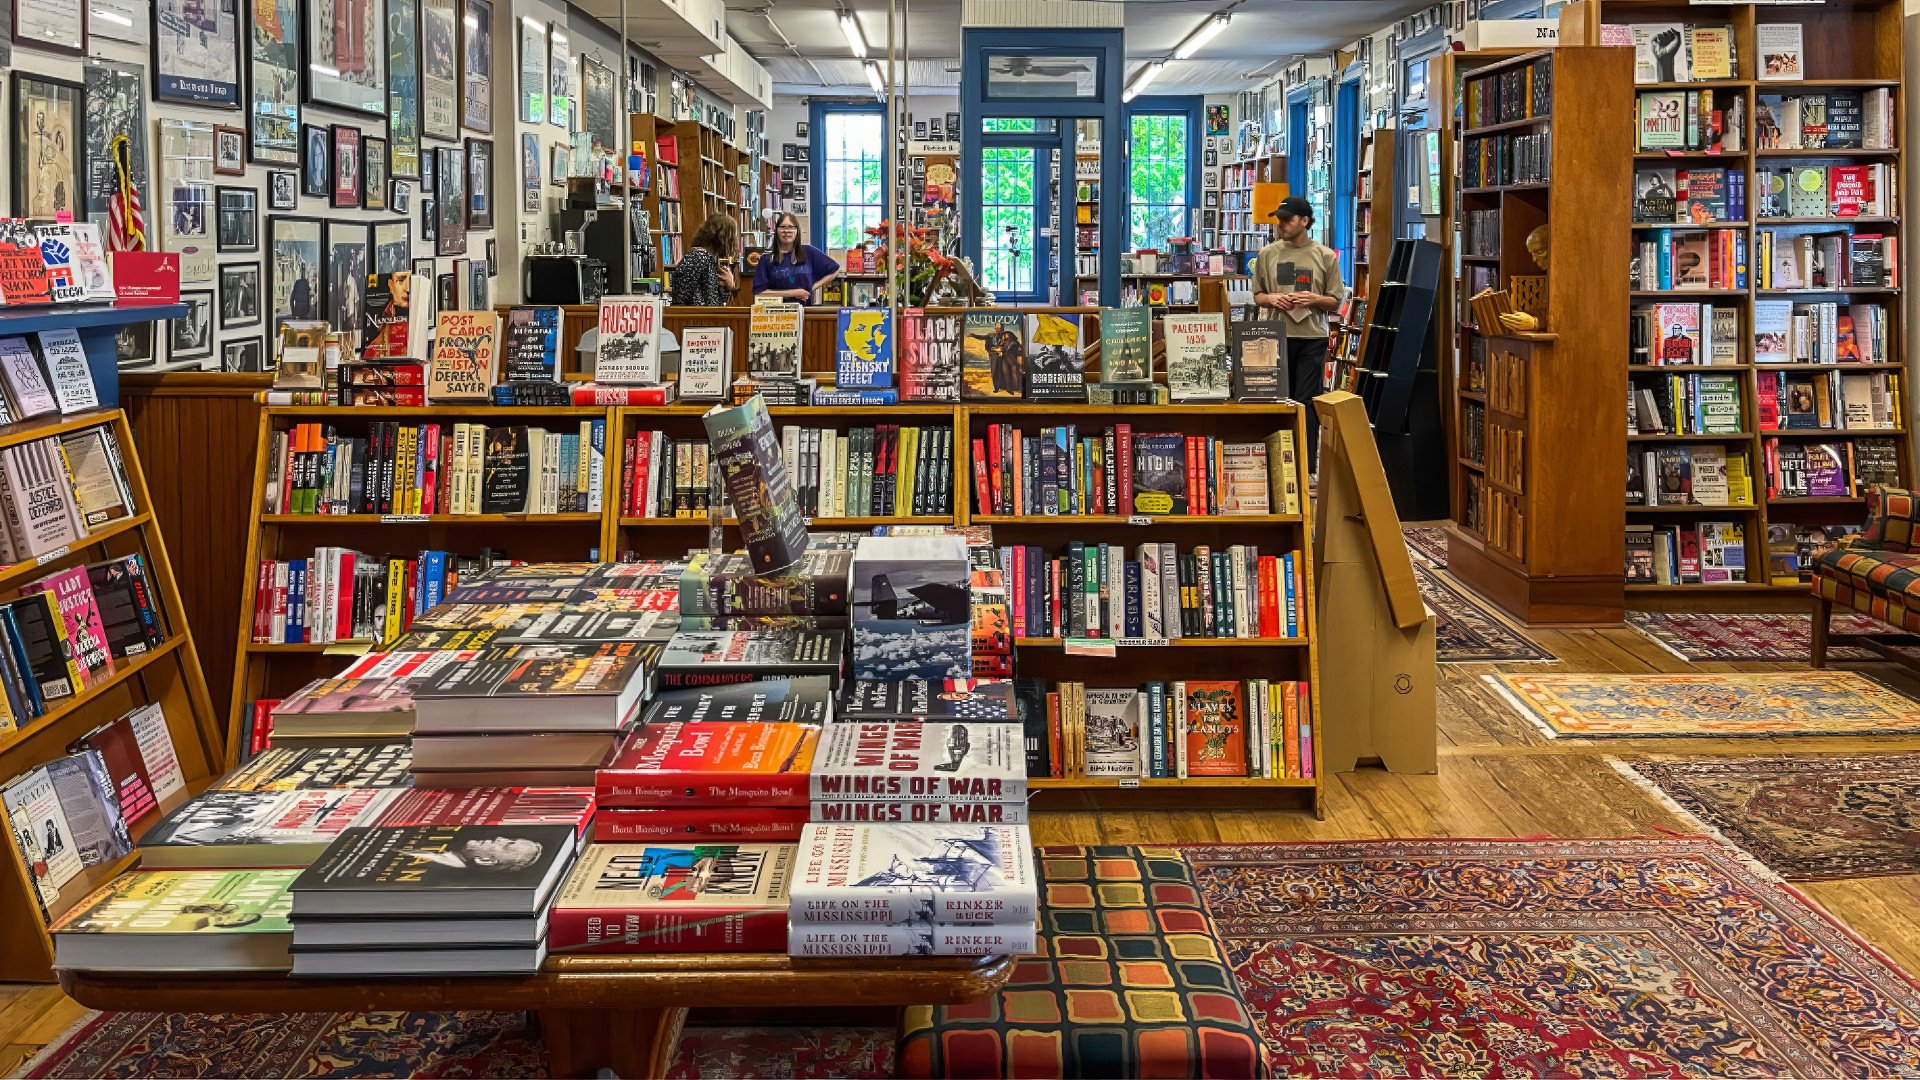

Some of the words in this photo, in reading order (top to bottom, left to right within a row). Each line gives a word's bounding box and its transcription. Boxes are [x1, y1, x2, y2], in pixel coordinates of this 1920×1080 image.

[441, 315, 474, 326] POST
[600, 304, 653, 334] RUSSIA
[966, 314, 1019, 325] KUTUZOV
[905, 316, 955, 340] BLACK
[1172, 323, 1218, 334] PALESTINE
[438, 336, 478, 348] FROM
[907, 342, 953, 366] SNOW
[839, 372, 873, 384] EFFECT
[1137, 456, 1174, 471] HIGH
[58, 575, 81, 595] LADY
[1127, 574, 1138, 624] ARABS
[664, 673, 681, 686] THE
[1190, 702, 1233, 712] SLAVES
[679, 732, 714, 757] Bowl
[892, 723, 923, 750] WAR
[635, 722, 683, 771] Mosquito
[854, 725, 889, 766] WINGS
[888, 753, 919, 771] OF
[709, 787, 726, 796] The
[771, 787, 793, 796] Bowl
[820, 774, 901, 794] WINGS
[909, 777, 941, 794] OF
[948, 778, 1002, 796] WAR
[821, 803, 901, 821] WINGS
[911, 803, 941, 821] OF
[950, 803, 1003, 822] WAR
[709, 824, 727, 832] The
[394, 825, 463, 882] TITAN
[827, 823, 854, 887] MISSISSIPPI
[806, 859, 823, 884] LIFE
[807, 901, 837, 909] LIFE
[841, 900, 859, 908] ON
[864, 900, 889, 908] THE
[946, 900, 1004, 910] RINKER
[804, 910, 893, 921] MISSISSIPPI
[955, 911, 993, 920] BUCK
[606, 924, 621, 936] TO
[806, 934, 836, 943] LIFE
[841, 935, 857, 943] ON
[863, 934, 888, 942] THE
[945, 936, 1002, 945] RINKER
[802, 944, 892, 955] MISSISSIPPI
